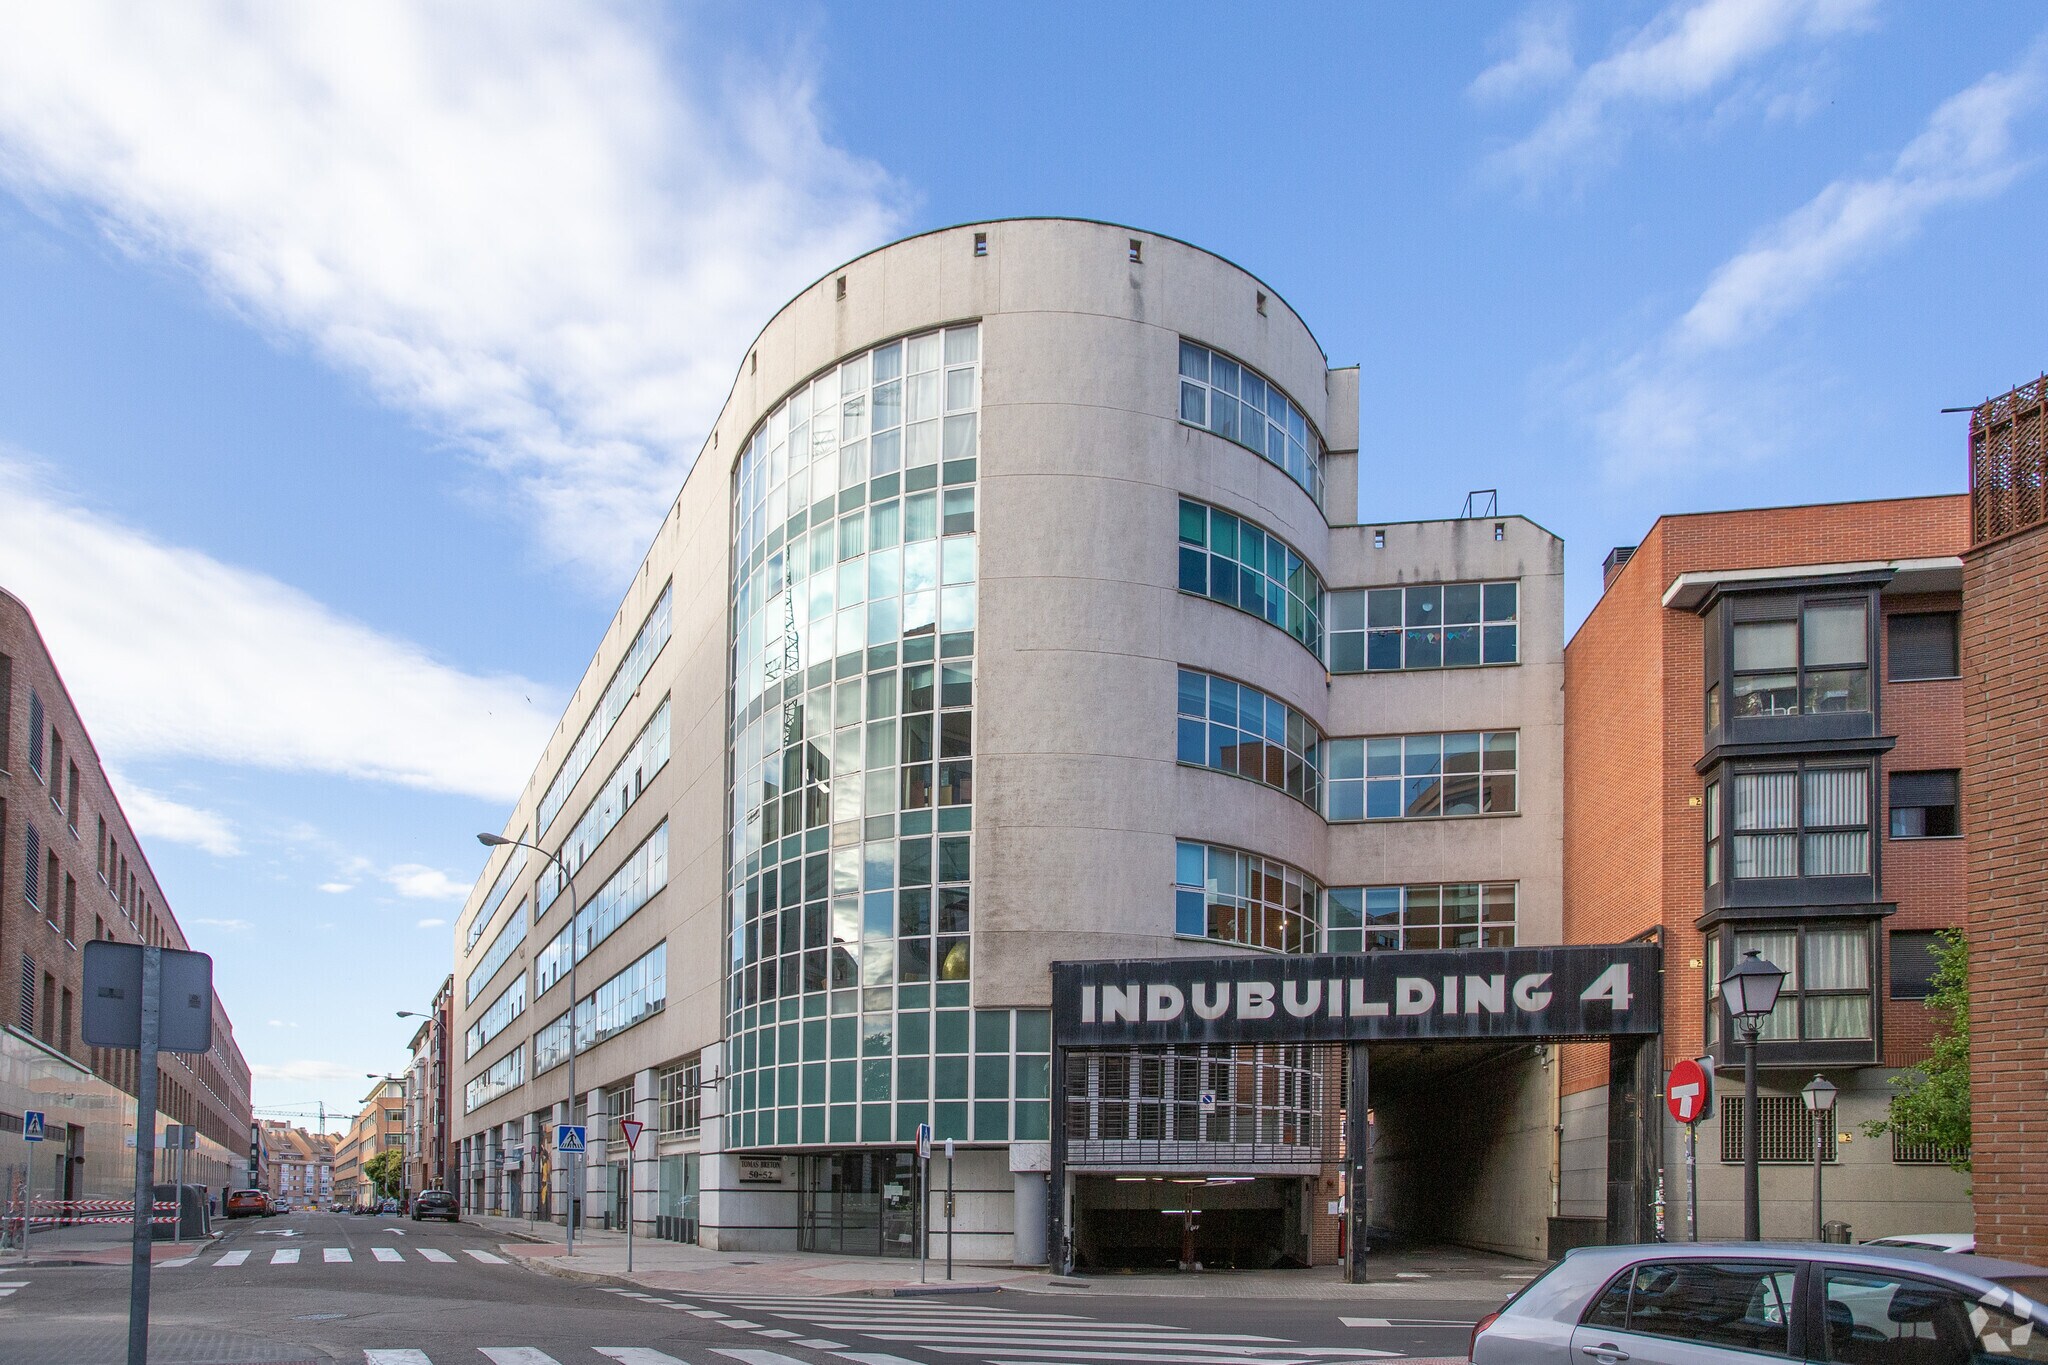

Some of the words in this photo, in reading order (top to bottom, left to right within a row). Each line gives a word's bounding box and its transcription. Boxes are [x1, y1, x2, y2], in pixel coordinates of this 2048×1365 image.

[1081, 972, 1553, 1023] INDUBUILDING
[1580, 963, 1634, 1011] 4
[749, 1171, 773, 1179] 50-52
